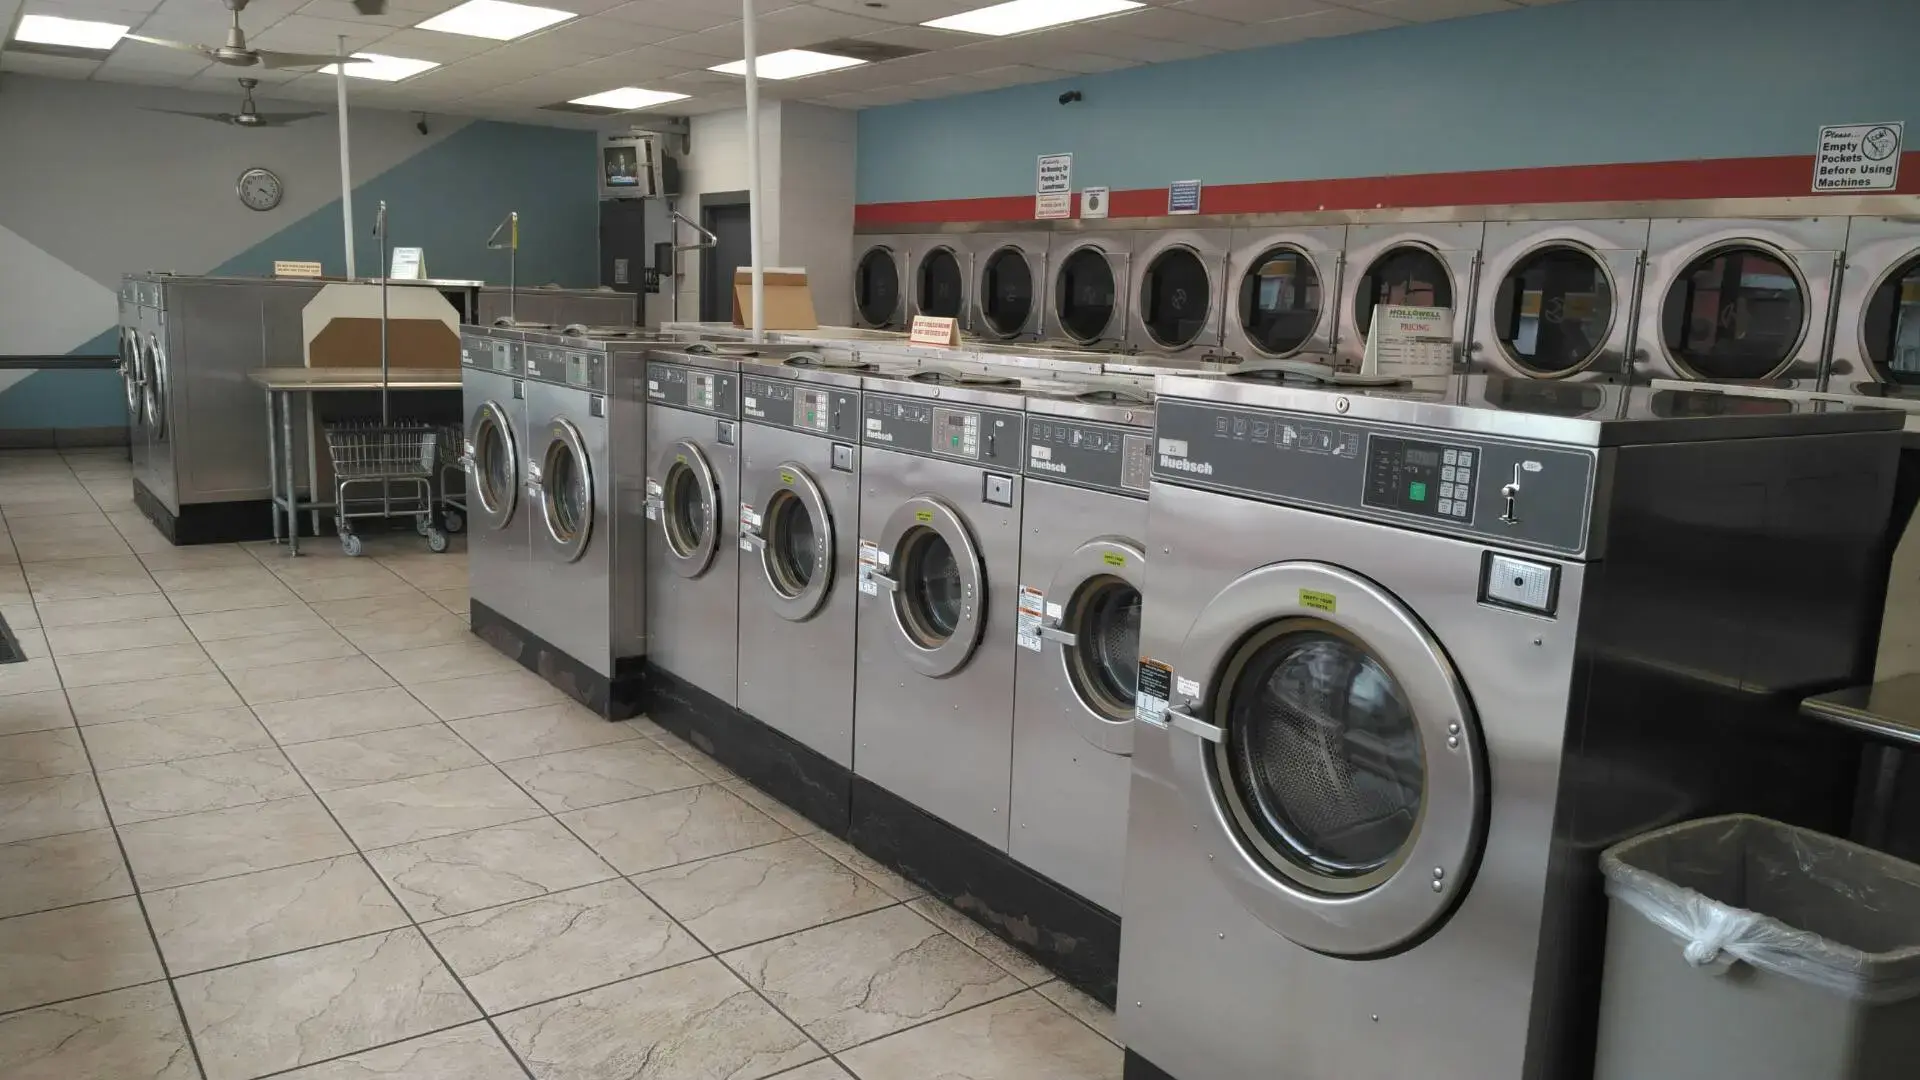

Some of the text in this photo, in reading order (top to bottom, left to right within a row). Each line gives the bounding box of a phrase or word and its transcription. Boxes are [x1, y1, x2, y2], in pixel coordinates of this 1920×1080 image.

[1823, 142, 1858, 152] Empty
[1821, 154, 1862, 163] Pockets
[1819, 164, 1893, 175] Before Using
[1818, 178, 1871, 187] Machines
[1389, 309, 1441, 317] HOLLOWELL
[1400, 322, 1431, 332] PRICING
[1031, 458, 1066, 473] Huebsch
[1160, 454, 1213, 475] Huebsch
